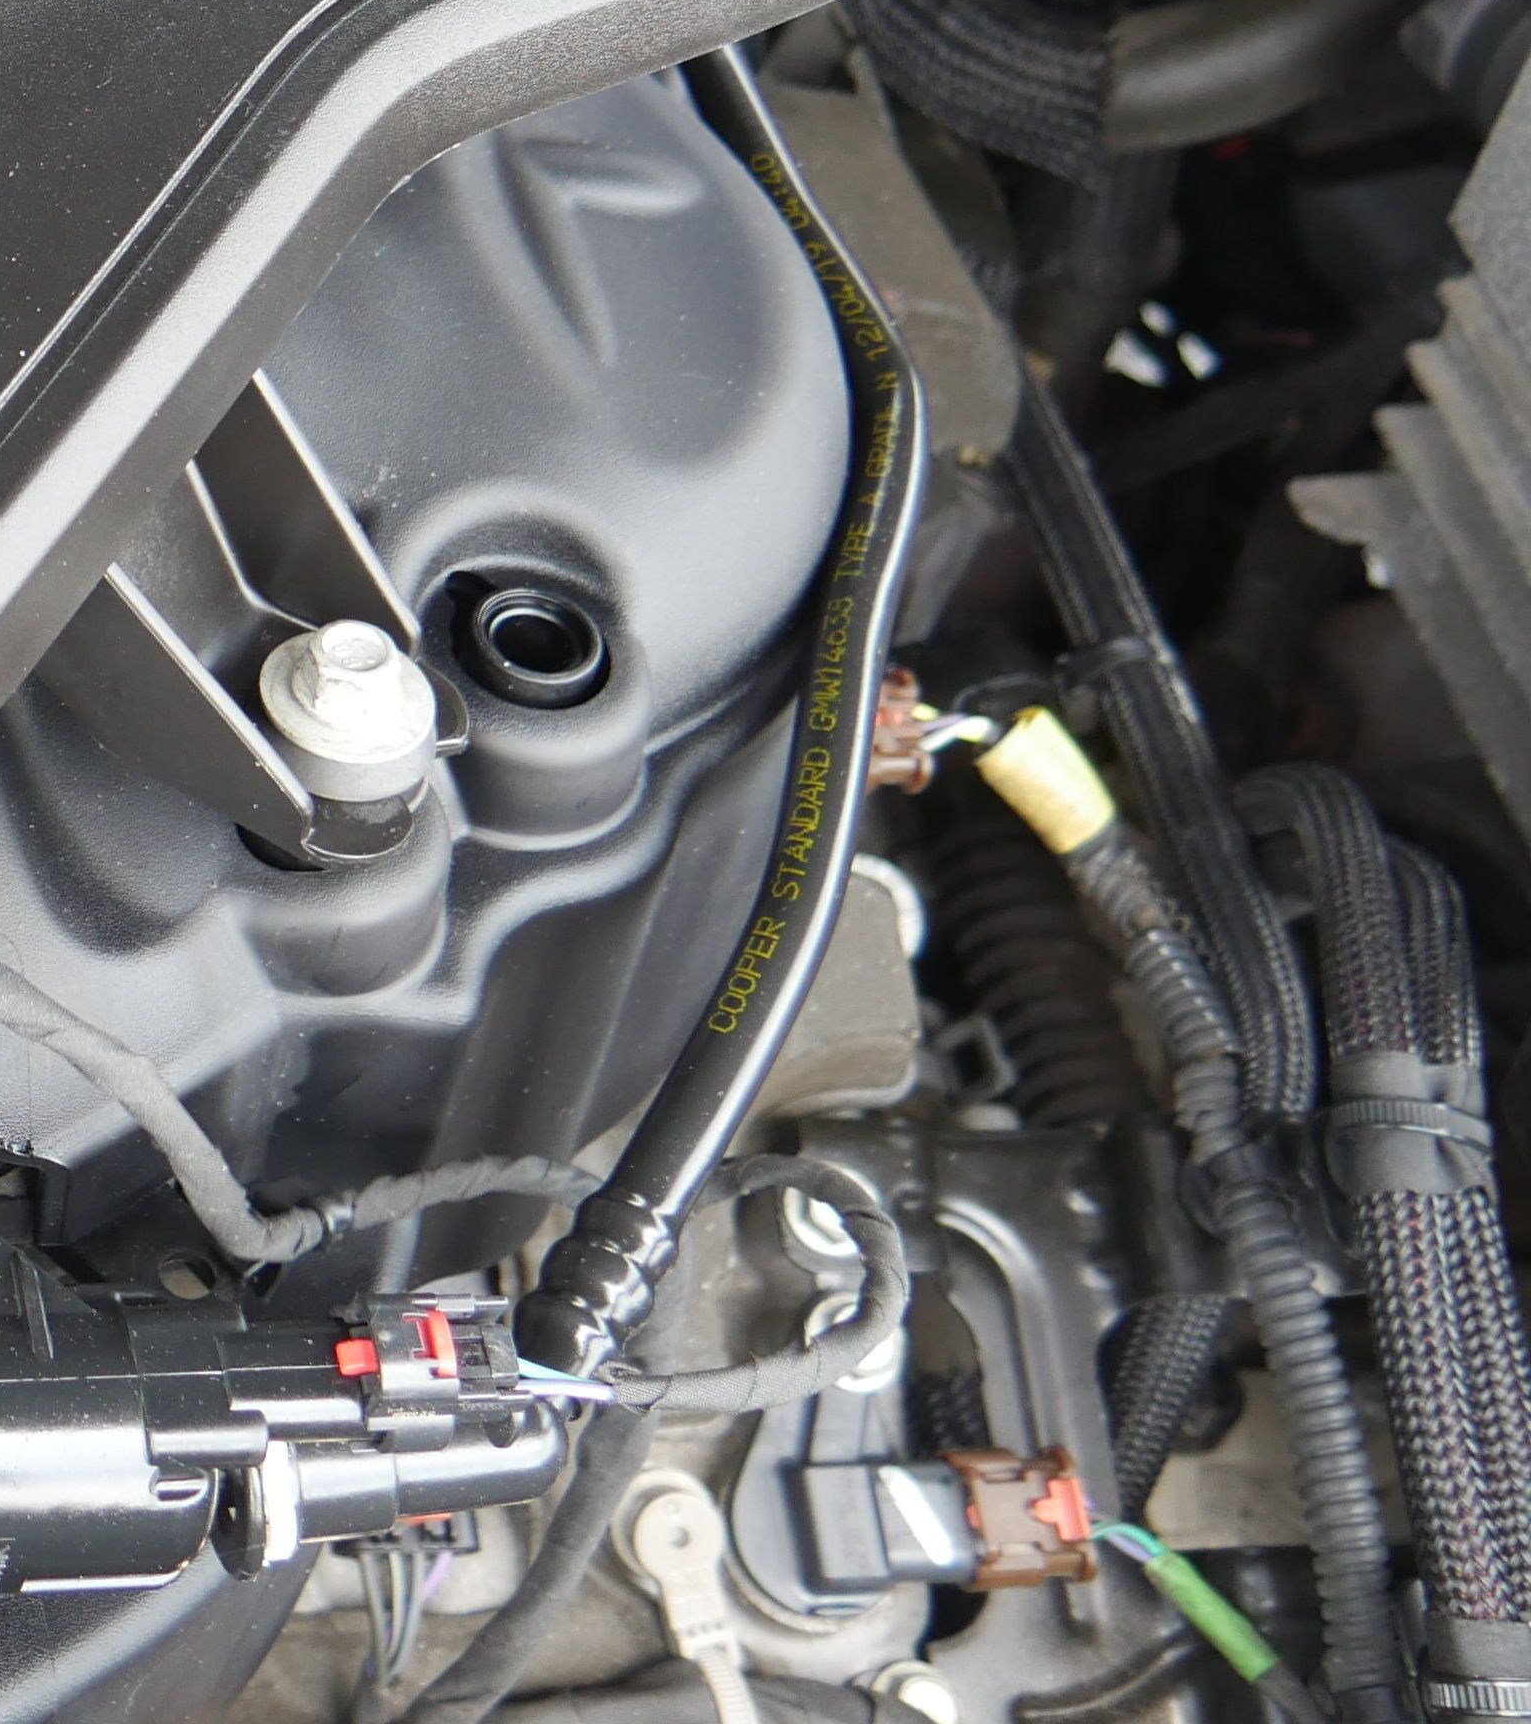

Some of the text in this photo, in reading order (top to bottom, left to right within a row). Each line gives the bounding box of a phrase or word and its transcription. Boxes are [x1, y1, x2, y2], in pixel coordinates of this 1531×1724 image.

[708, 915, 786, 1034] COOPER
[771, 746, 832, 901] STANDARD
[809, 595, 854, 732] GMW14638
[835, 524, 876, 583] TYPE
